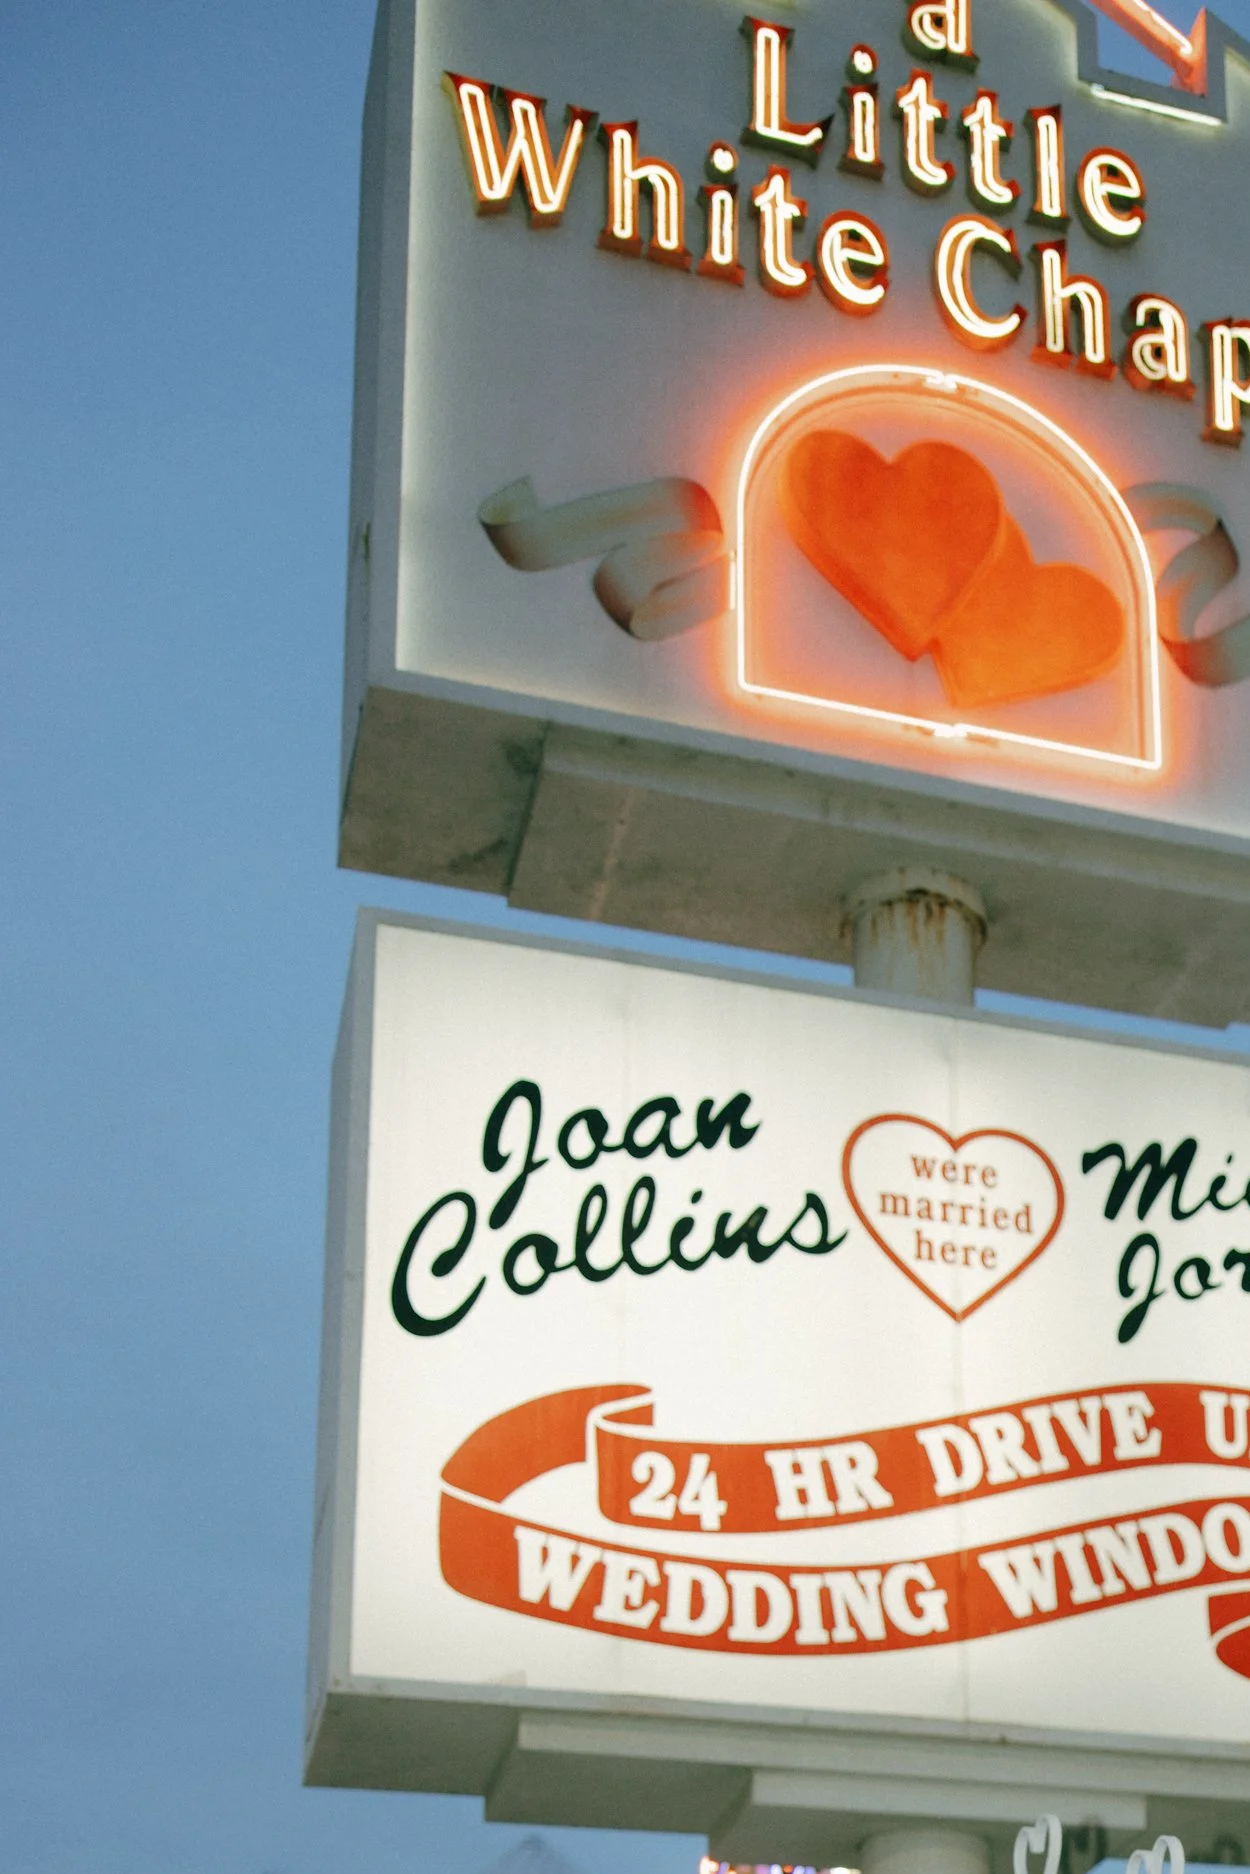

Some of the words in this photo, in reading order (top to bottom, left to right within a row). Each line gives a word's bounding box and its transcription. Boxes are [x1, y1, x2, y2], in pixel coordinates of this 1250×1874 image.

[442, 70, 890, 317] White
[740, 15, 1147, 246] Little
[481, 1079, 762, 1231] Joan
[877, 1189, 1034, 1236] married
[909, 1149, 999, 1190] were
[390, 1175, 848, 1338] Collins
[912, 1227, 999, 1271] here
[628, 1451, 728, 1531] 24
[763, 1440, 894, 1521] HR
[916, 1390, 1162, 1497] DRIVE
[513, 1526, 949, 1645] WEDDING
